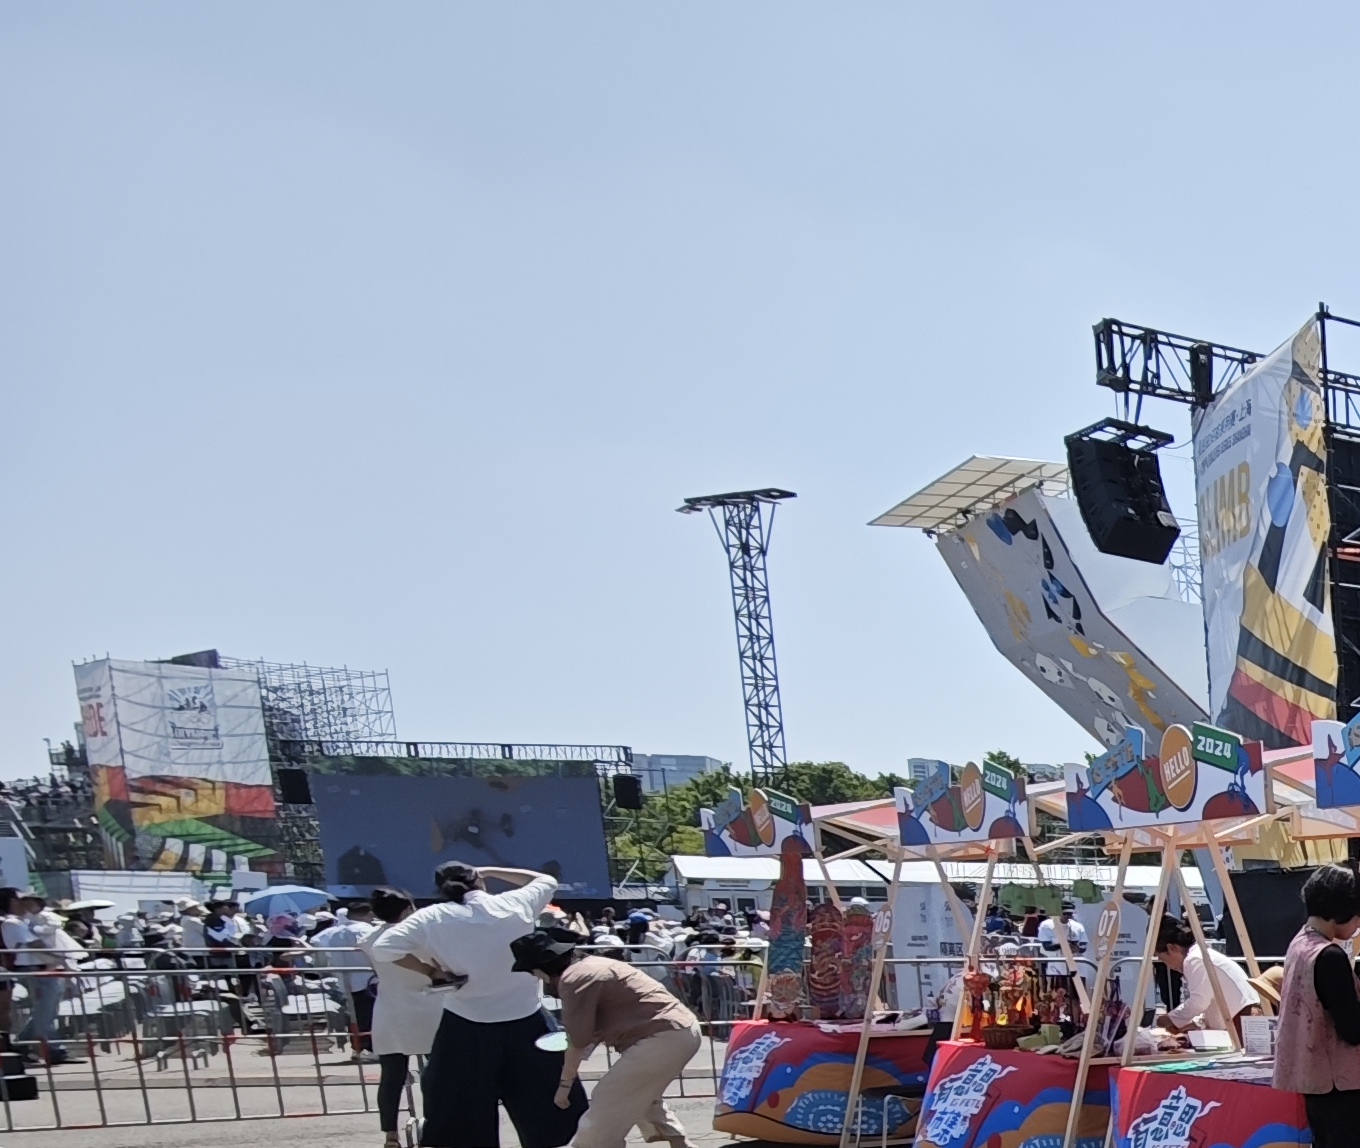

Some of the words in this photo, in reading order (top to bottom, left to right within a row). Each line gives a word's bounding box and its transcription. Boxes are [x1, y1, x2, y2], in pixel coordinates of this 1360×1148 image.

[1196, 735, 1233, 759] 2024
[1163, 746, 1191, 783] HELLO
[984, 770, 1008, 790] 2024
[874, 910, 891, 934] 06
[1098, 909, 1118, 937] 07
